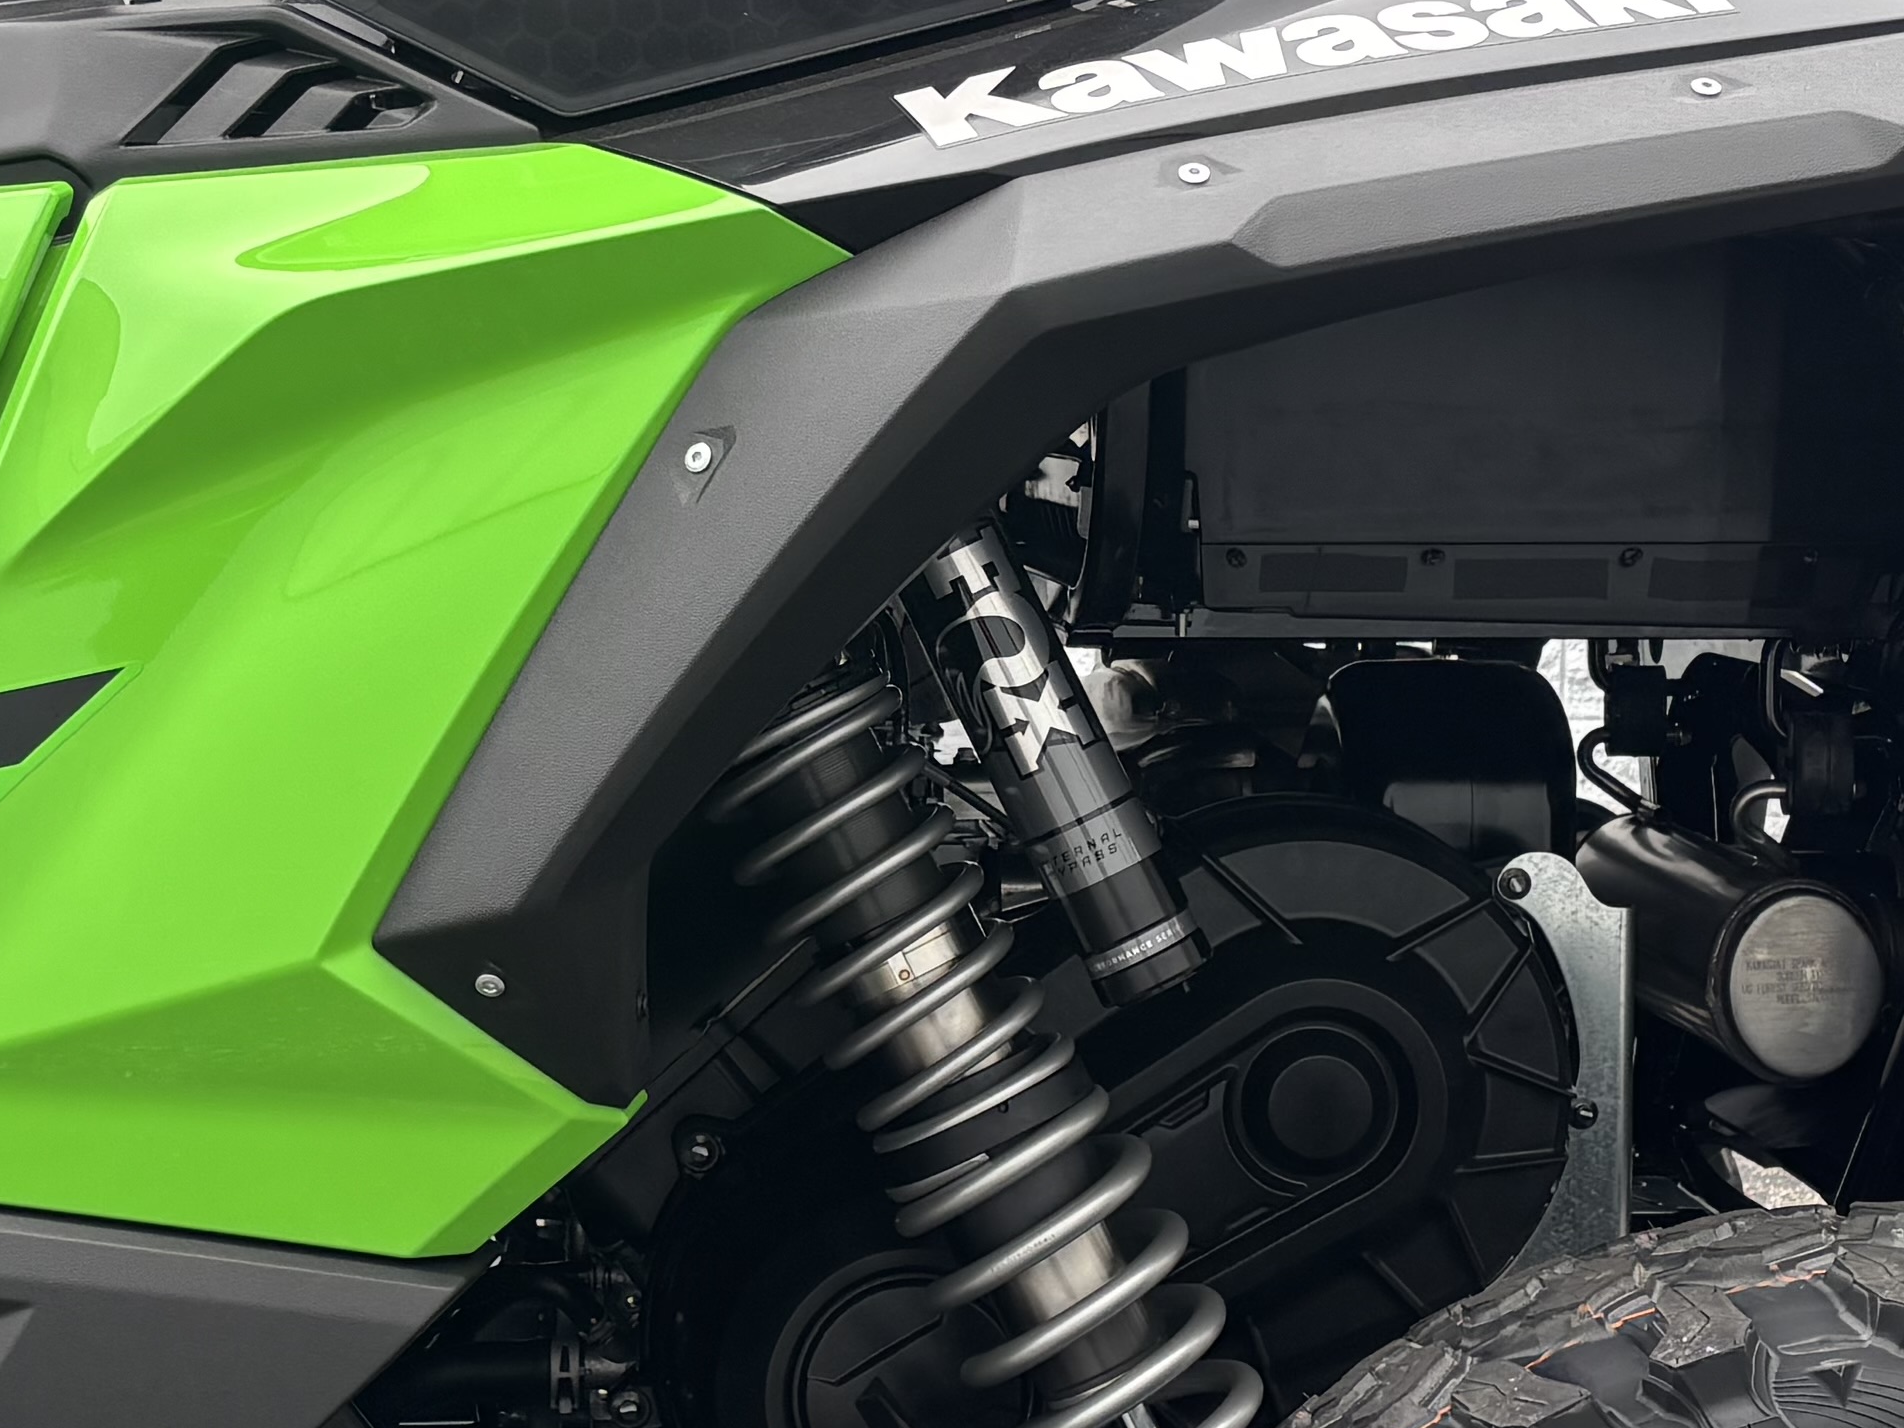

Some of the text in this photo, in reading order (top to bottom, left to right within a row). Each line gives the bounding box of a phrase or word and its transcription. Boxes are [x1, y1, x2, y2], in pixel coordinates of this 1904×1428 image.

[923, 524, 1097, 777] FOX
[1041, 828, 1122, 868] TERNAL
[1056, 843, 1118, 877] YPASS
